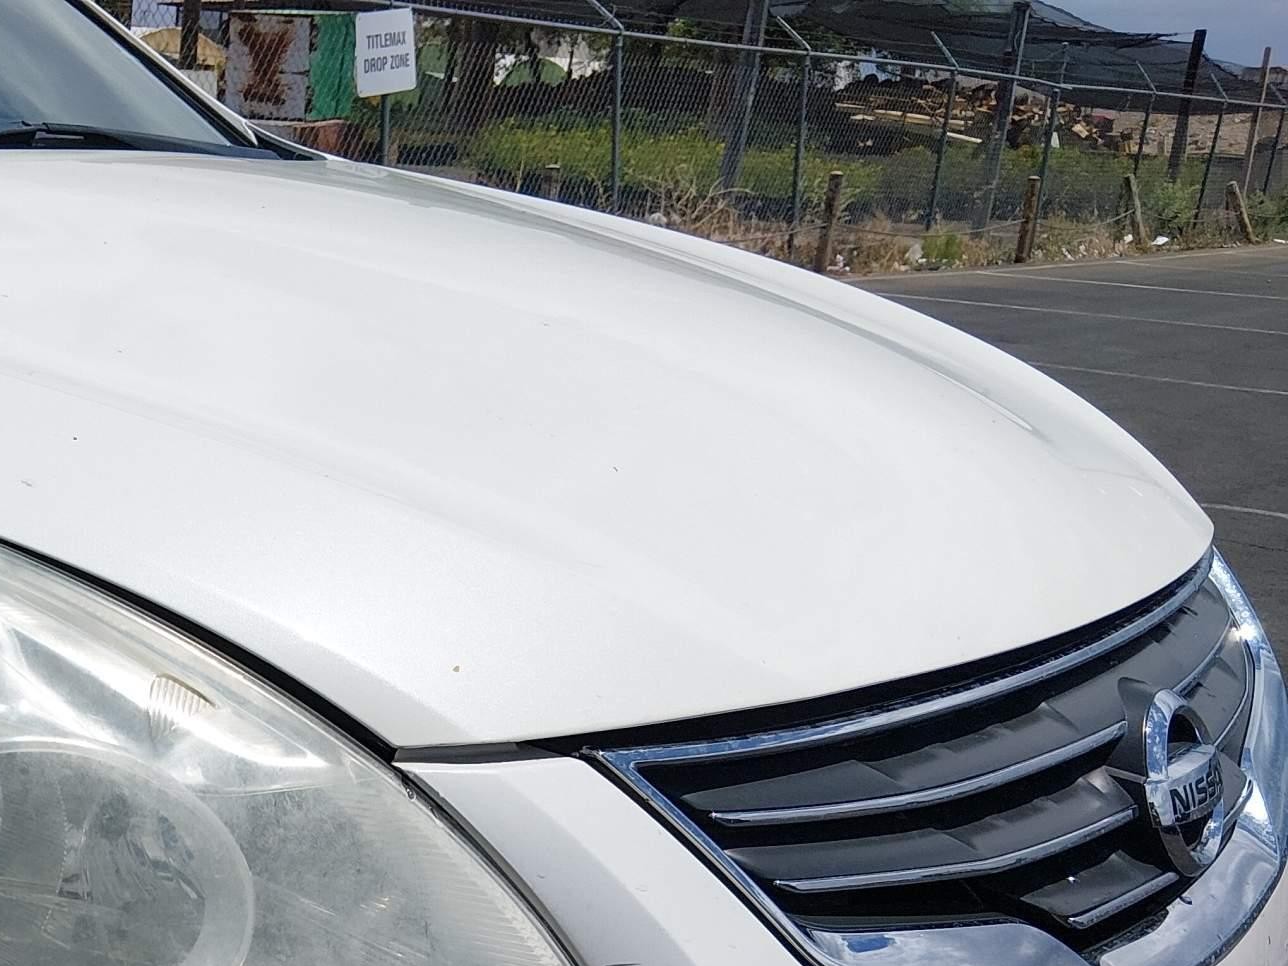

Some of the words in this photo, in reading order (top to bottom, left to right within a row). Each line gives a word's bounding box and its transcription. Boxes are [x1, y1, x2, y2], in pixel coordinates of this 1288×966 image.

[366, 31, 407, 50] TITLEMAX
[363, 55, 388, 74] DROP
[390, 52, 410, 70] ZONE
